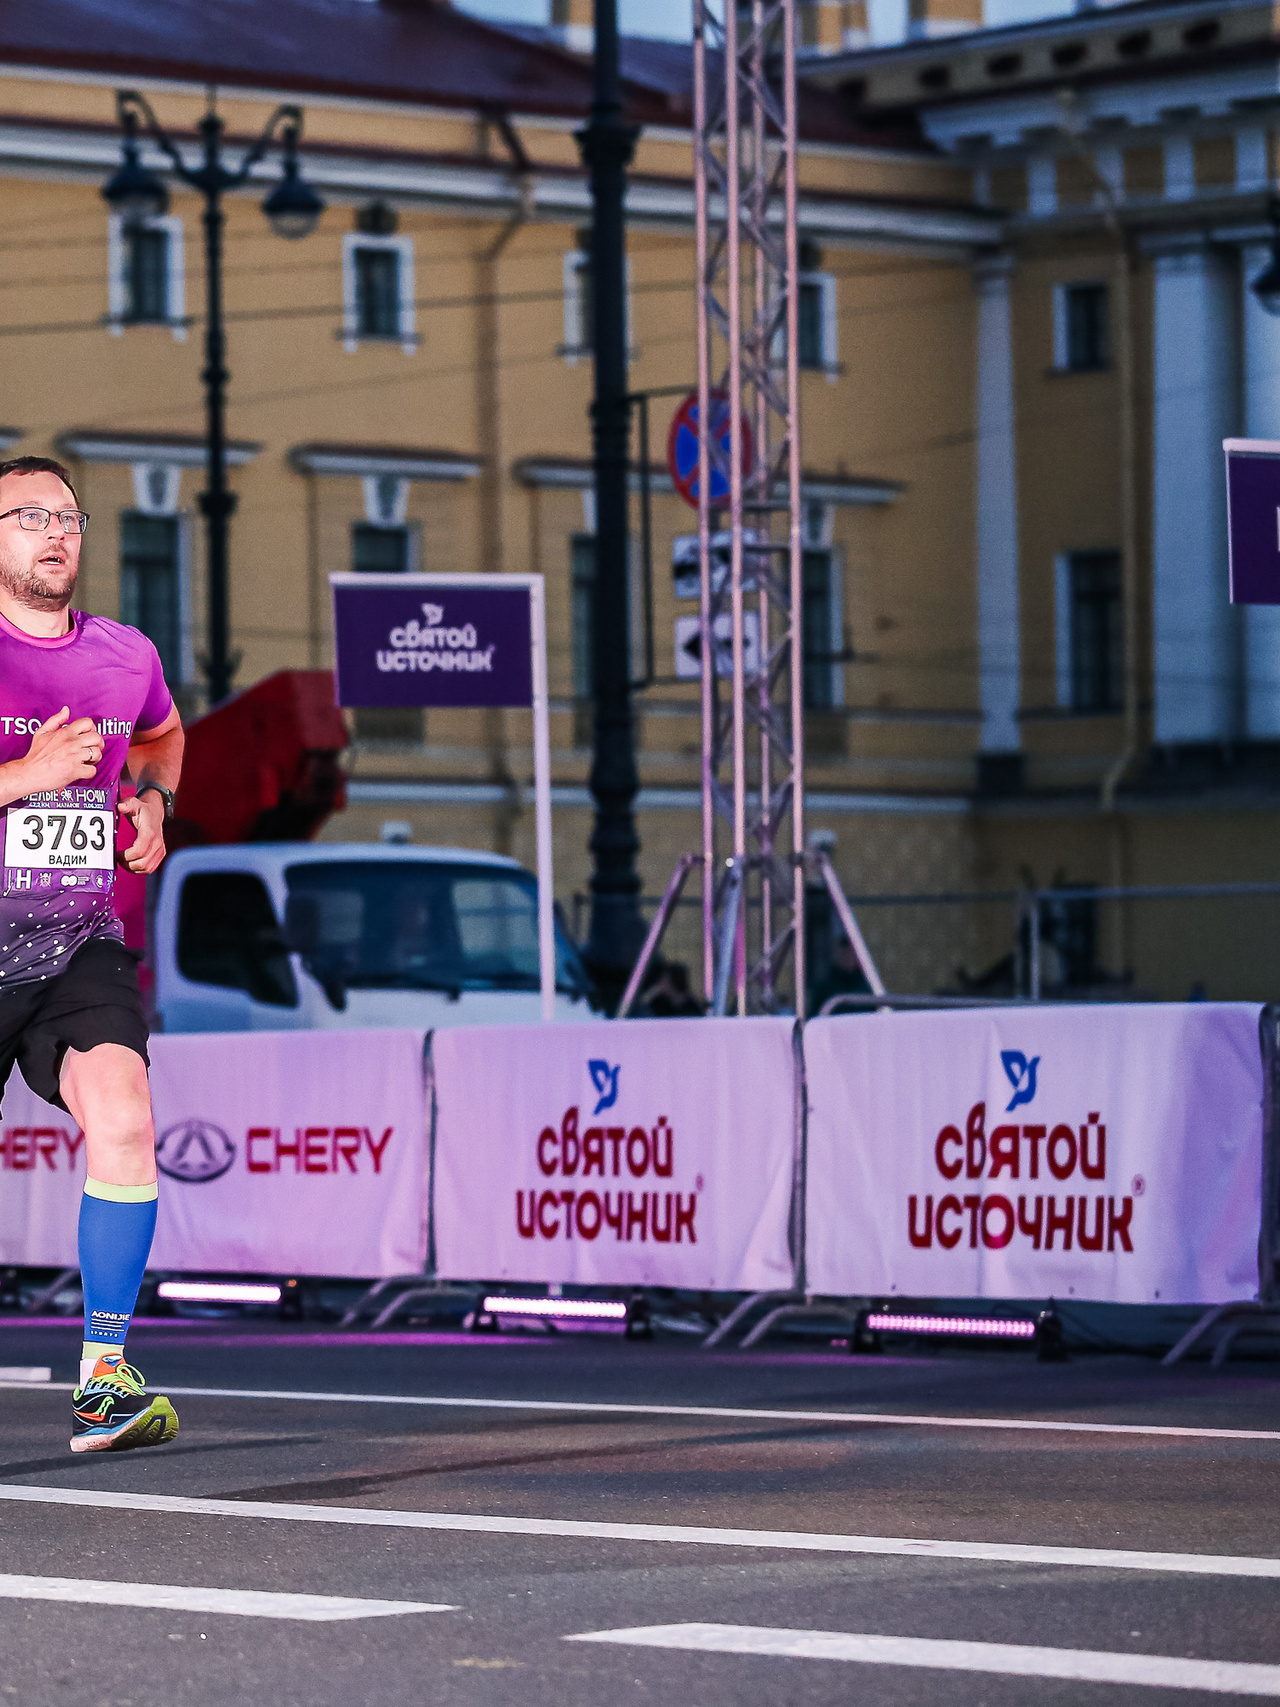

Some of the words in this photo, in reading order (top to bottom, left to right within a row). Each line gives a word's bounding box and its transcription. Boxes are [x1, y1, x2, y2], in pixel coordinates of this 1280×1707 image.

[21, 814, 106, 851] 3763
[48, 855, 88, 867] ВАДИМ
[246, 1126, 394, 1174] CHERY
[91, 1310, 131, 1321] AONIJIE
